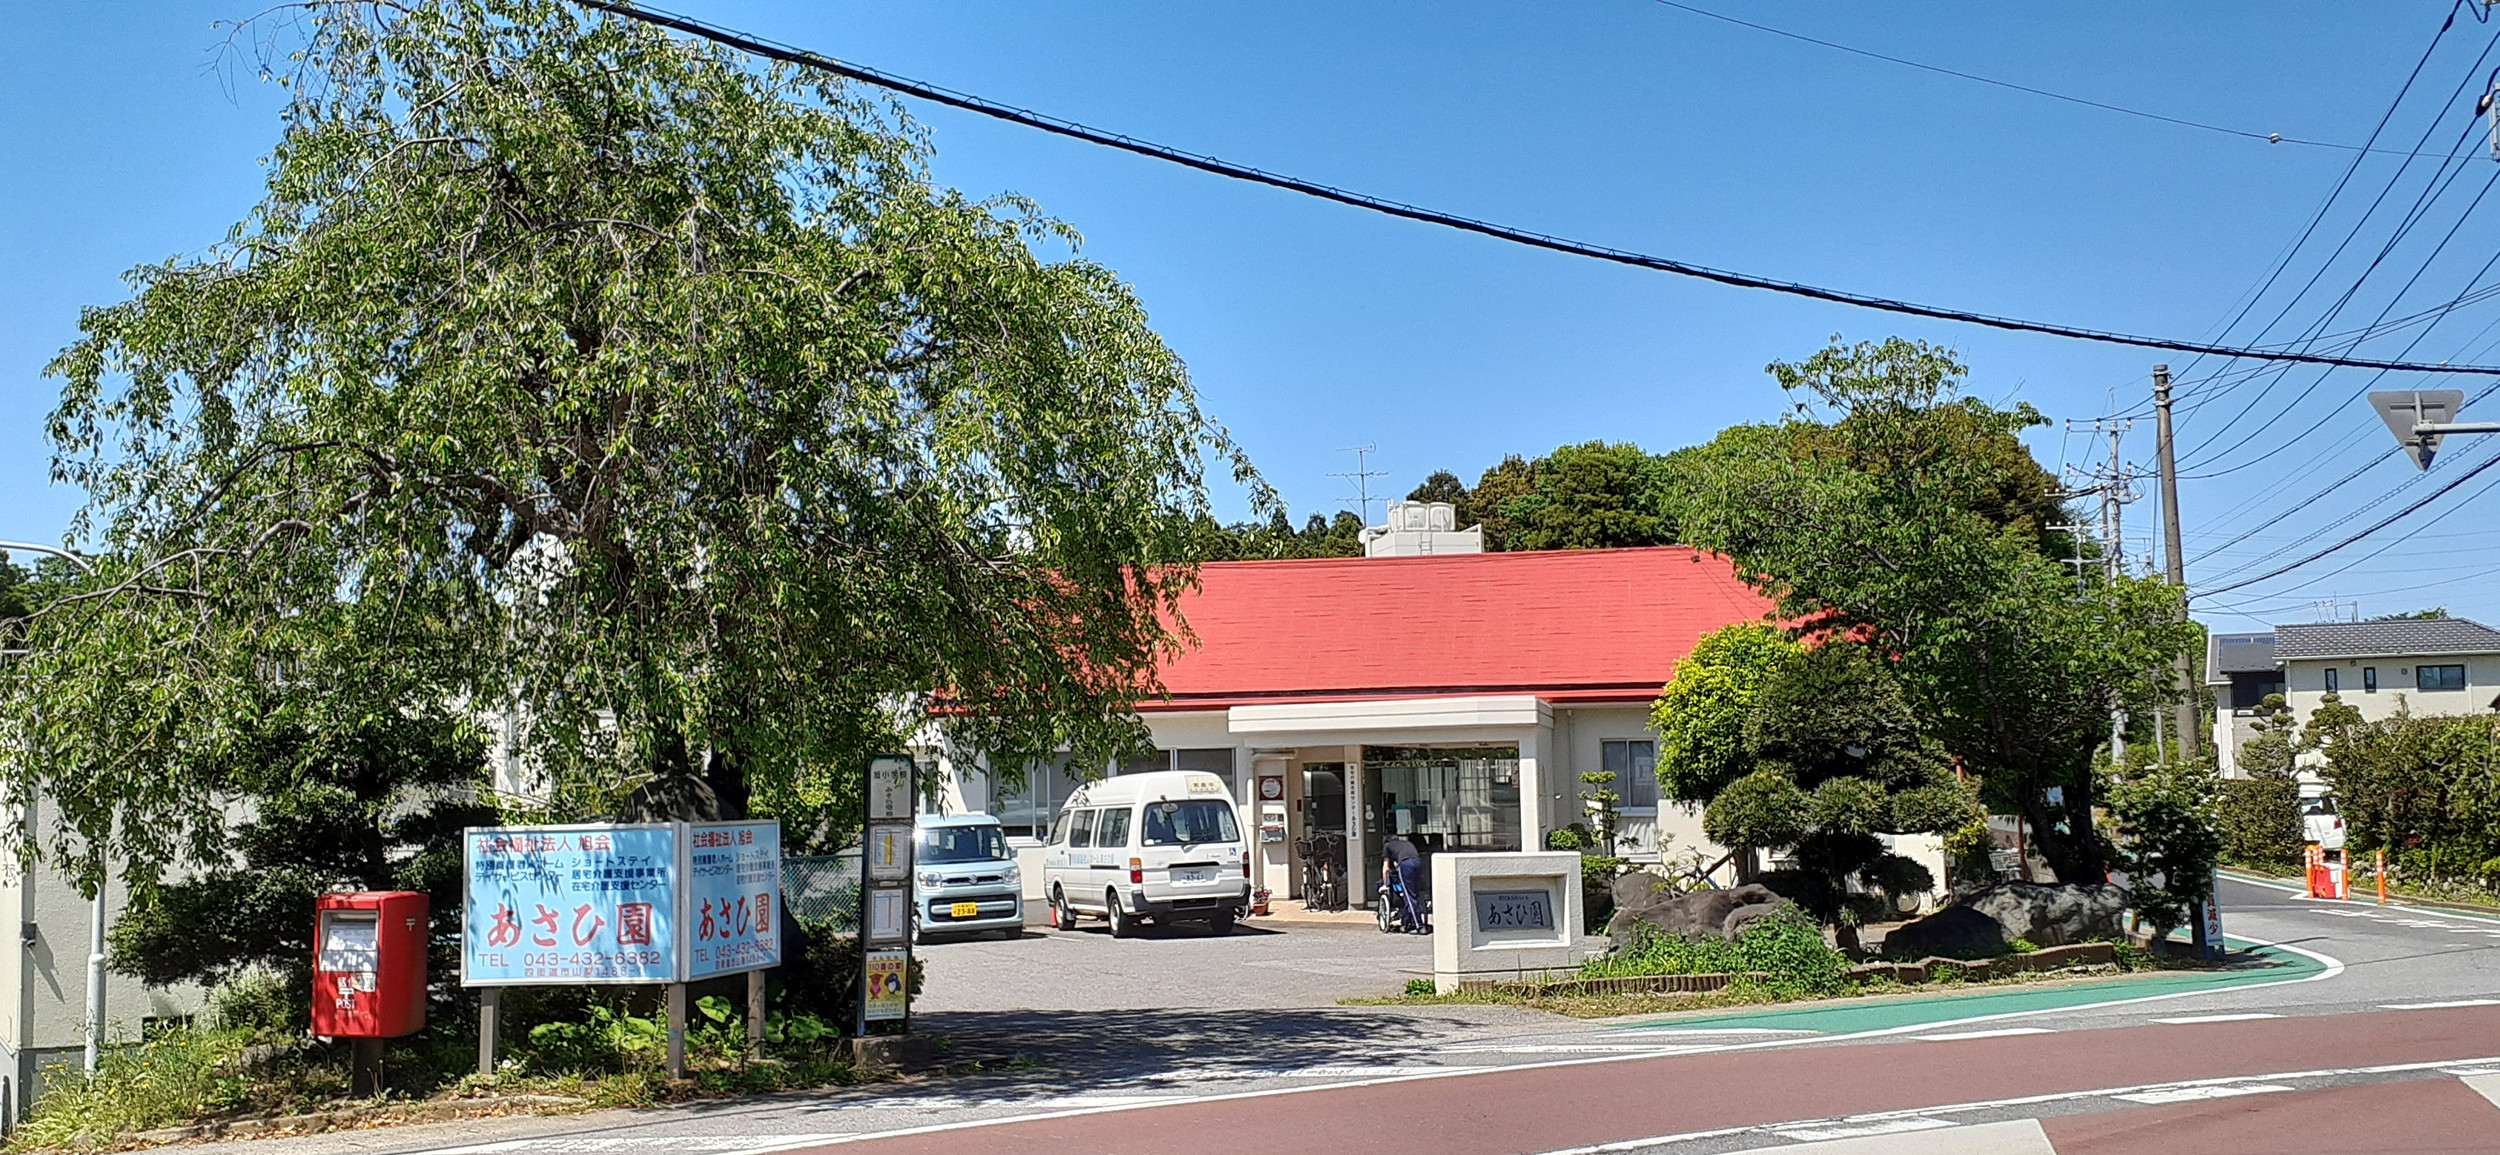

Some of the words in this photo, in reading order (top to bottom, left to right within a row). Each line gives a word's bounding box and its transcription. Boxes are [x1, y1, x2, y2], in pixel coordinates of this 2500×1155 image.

[476, 837, 572, 854] 社会福祉法人
[577, 834, 611, 851] 旭会
[693, 831, 737, 848] 社会福祉法人
[571, 855, 651, 867] ショートステイ
[571, 867, 666, 880] 居宅介護支援事業所
[571, 879, 667, 892] 在宅介護支援センター
[698, 893, 770, 941] あさひ園
[1488, 901, 1544, 926] あさひ園
[487, 902, 653, 948] あさひ園
[479, 953, 510, 967] TEL
[524, 951, 660, 966] 043-432-6382
[695, 948, 709, 962] TEL
[715, 938, 773, 959] 043-432-6382
